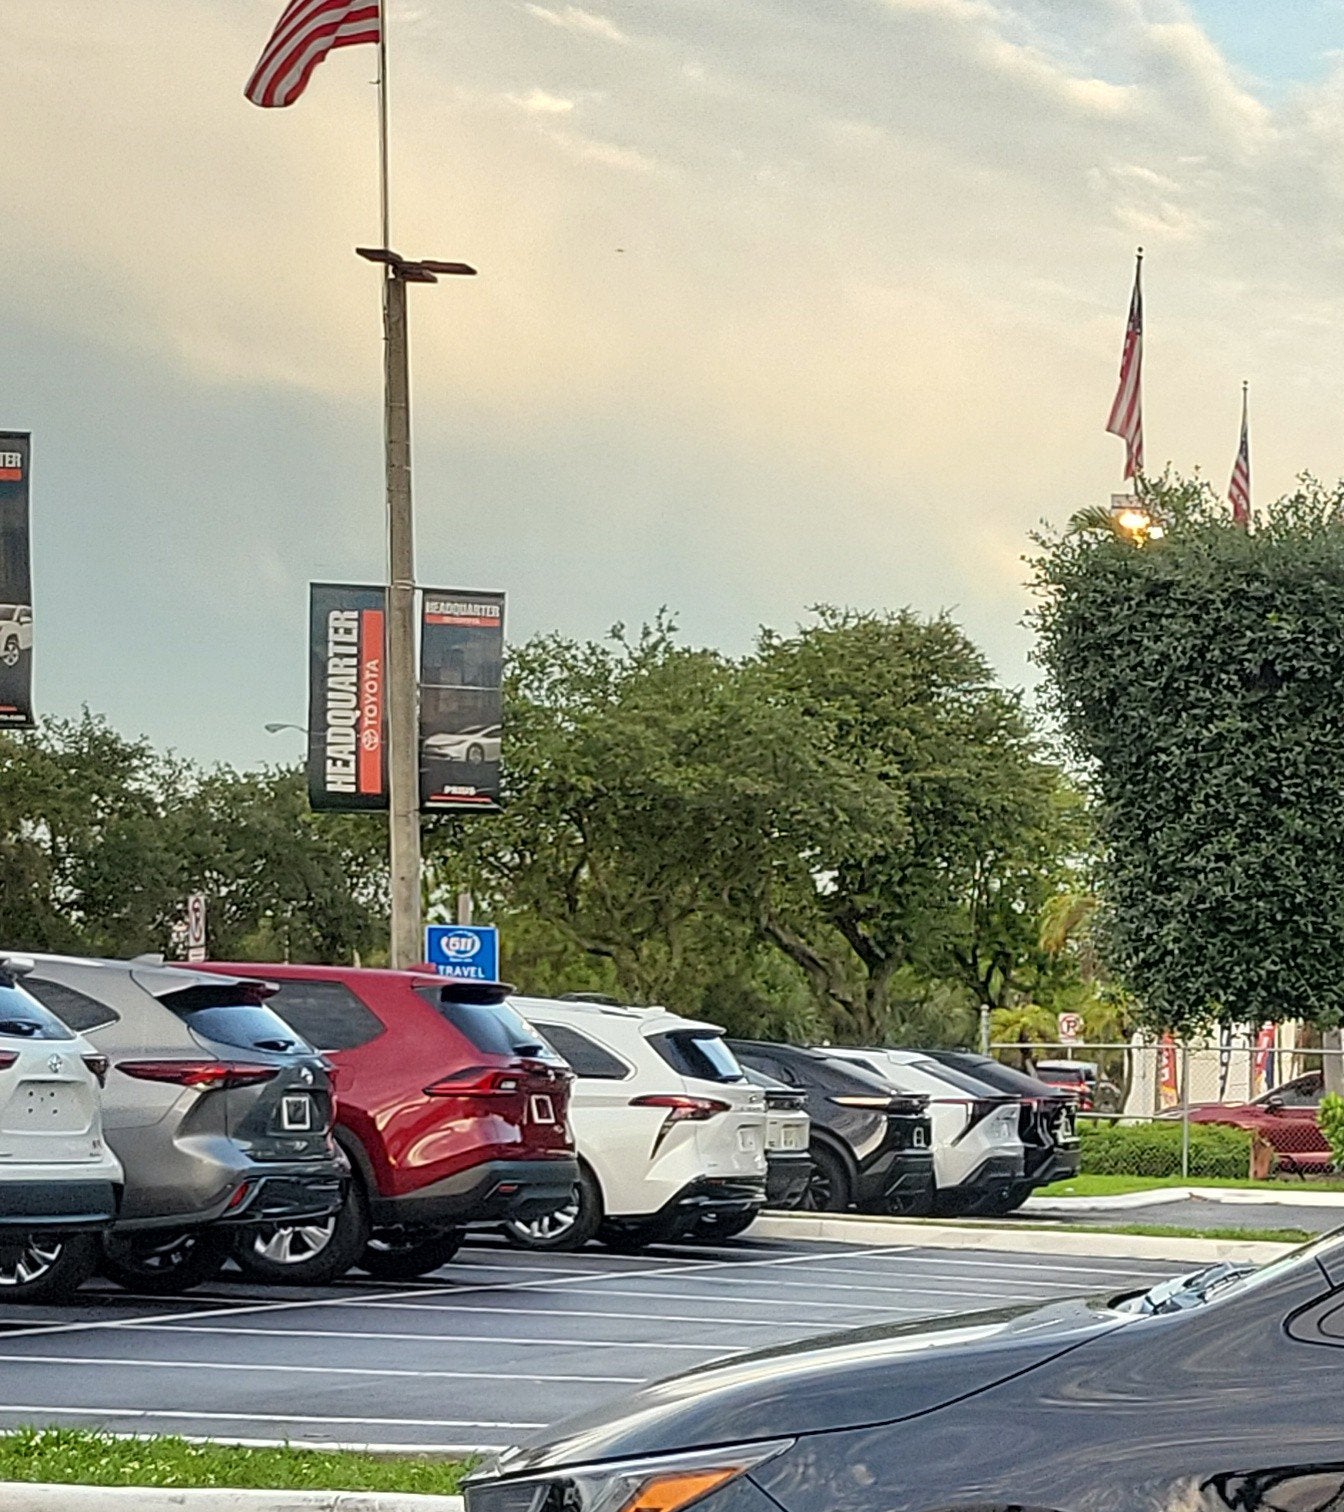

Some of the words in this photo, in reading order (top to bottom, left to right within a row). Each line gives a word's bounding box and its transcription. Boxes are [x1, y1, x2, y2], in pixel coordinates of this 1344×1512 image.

[326, 609, 361, 794] HEADQUARTER
[365, 659, 381, 726] TOYOTA
[438, 965, 485, 978] TRAVEL
